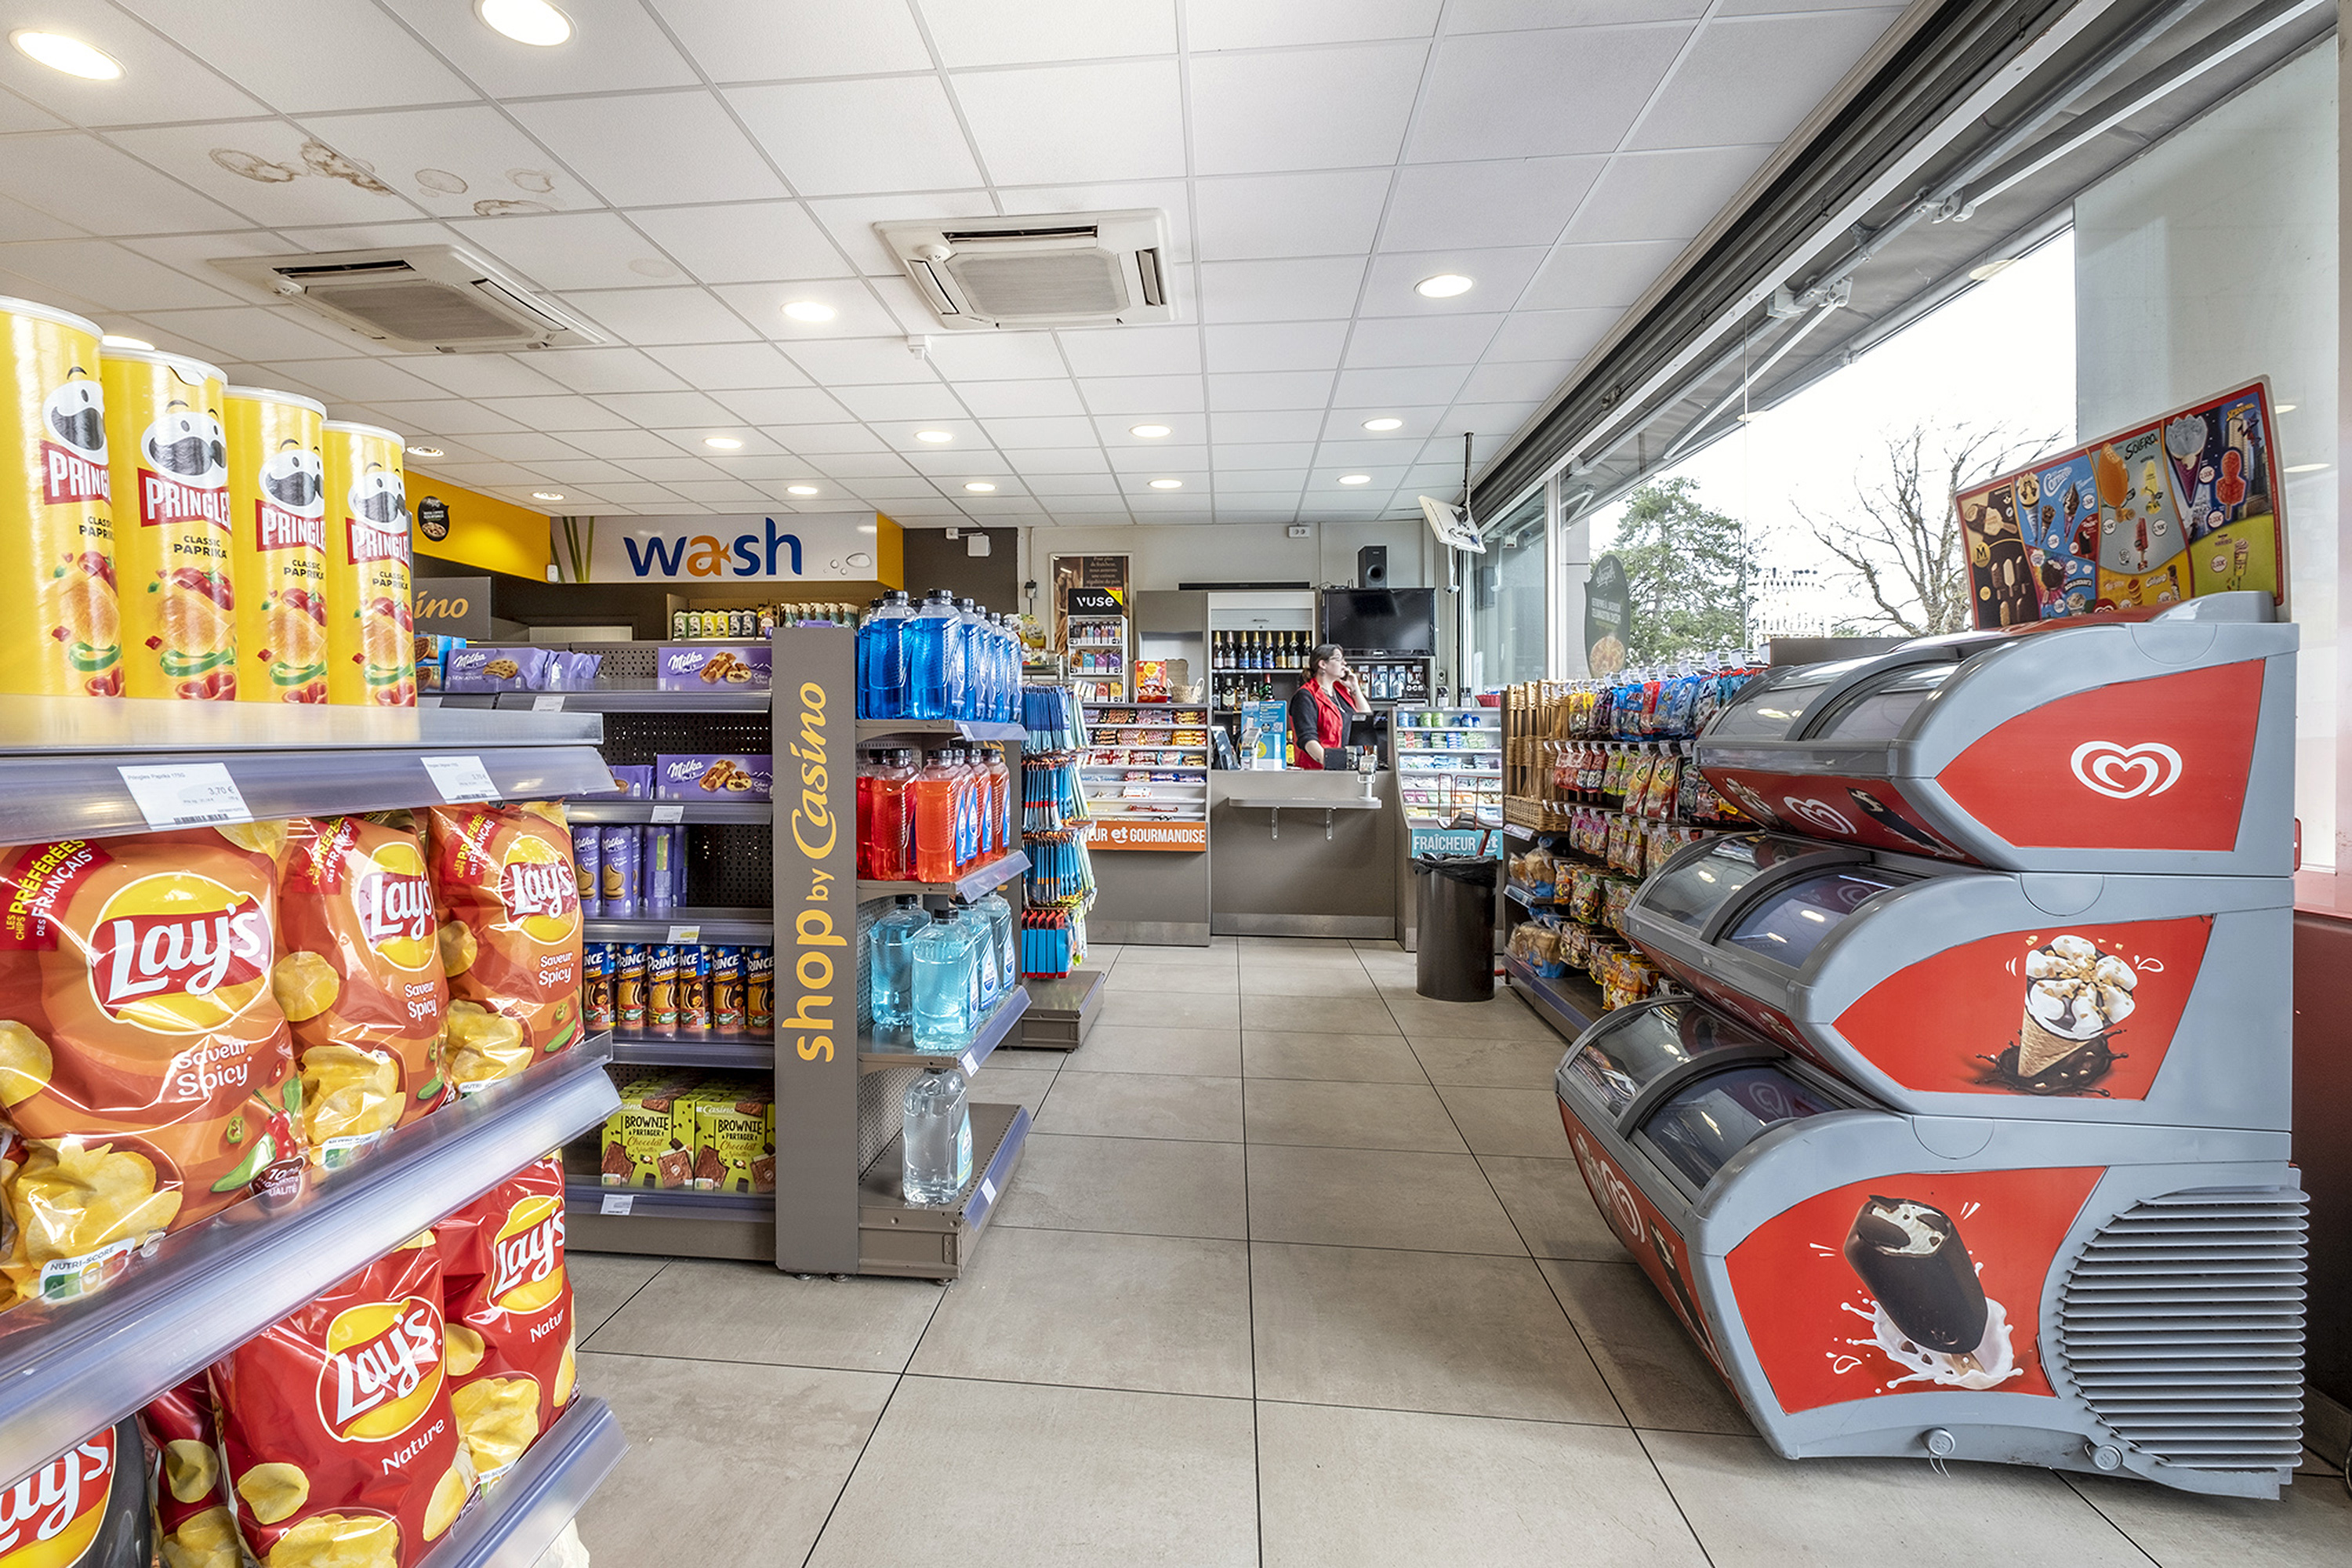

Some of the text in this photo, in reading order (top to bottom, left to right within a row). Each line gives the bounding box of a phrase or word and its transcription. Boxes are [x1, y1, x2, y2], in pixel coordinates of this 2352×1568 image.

[173, 543, 227, 559] PAPRIKA
[184, 535, 220, 547] CLASSIC
[623, 517, 802, 576] wash
[453, 652, 487, 668] Milka
[667, 652, 704, 670] Milka
[666, 759, 703, 778] Milka
[208, 786, 235, 796] 3,70 €
[1111, 827, 1128, 839] et
[1130, 829, 1206, 843] GOURMANDISE
[1414, 832, 1476, 851] FRAÎCHEUR
[9, 839, 86, 915] PRÉFÉRÉES
[782, 682, 848, 1062] shop by Casino
[31, 848, 94, 937] DES FRANÇAIS
[513, 859, 573, 918] Lay's
[371, 872, 434, 941] Lay's
[7, 914, 16, 931] LES
[16, 916, 26, 941] CHIPS
[104, 902, 263, 1006] Lay's
[540, 952, 573, 967] Saveur
[680, 953, 699, 966] NCE
[539, 966, 572, 987] Spicy
[405, 981, 434, 998] Saveur
[407, 997, 437, 1021] Spicy
[176, 1058, 249, 1098] Spicy
[702, 1105, 735, 1114] Casino
[625, 1116, 669, 1131] BROWNIE
[717, 1120, 762, 1134] BROWNIE
[626, 1136, 664, 1148] Chocolat
[719, 1140, 757, 1151] Chocolat
[50, 1245, 116, 1271] NUTRI-SCORE
[492, 1207, 564, 1300] Lay's
[529, 1308, 564, 1343] Natur
[336, 1308, 436, 1425] Lay's
[380, 1418, 445, 1475] Nature
[0, 1441, 109, 1552] ays
